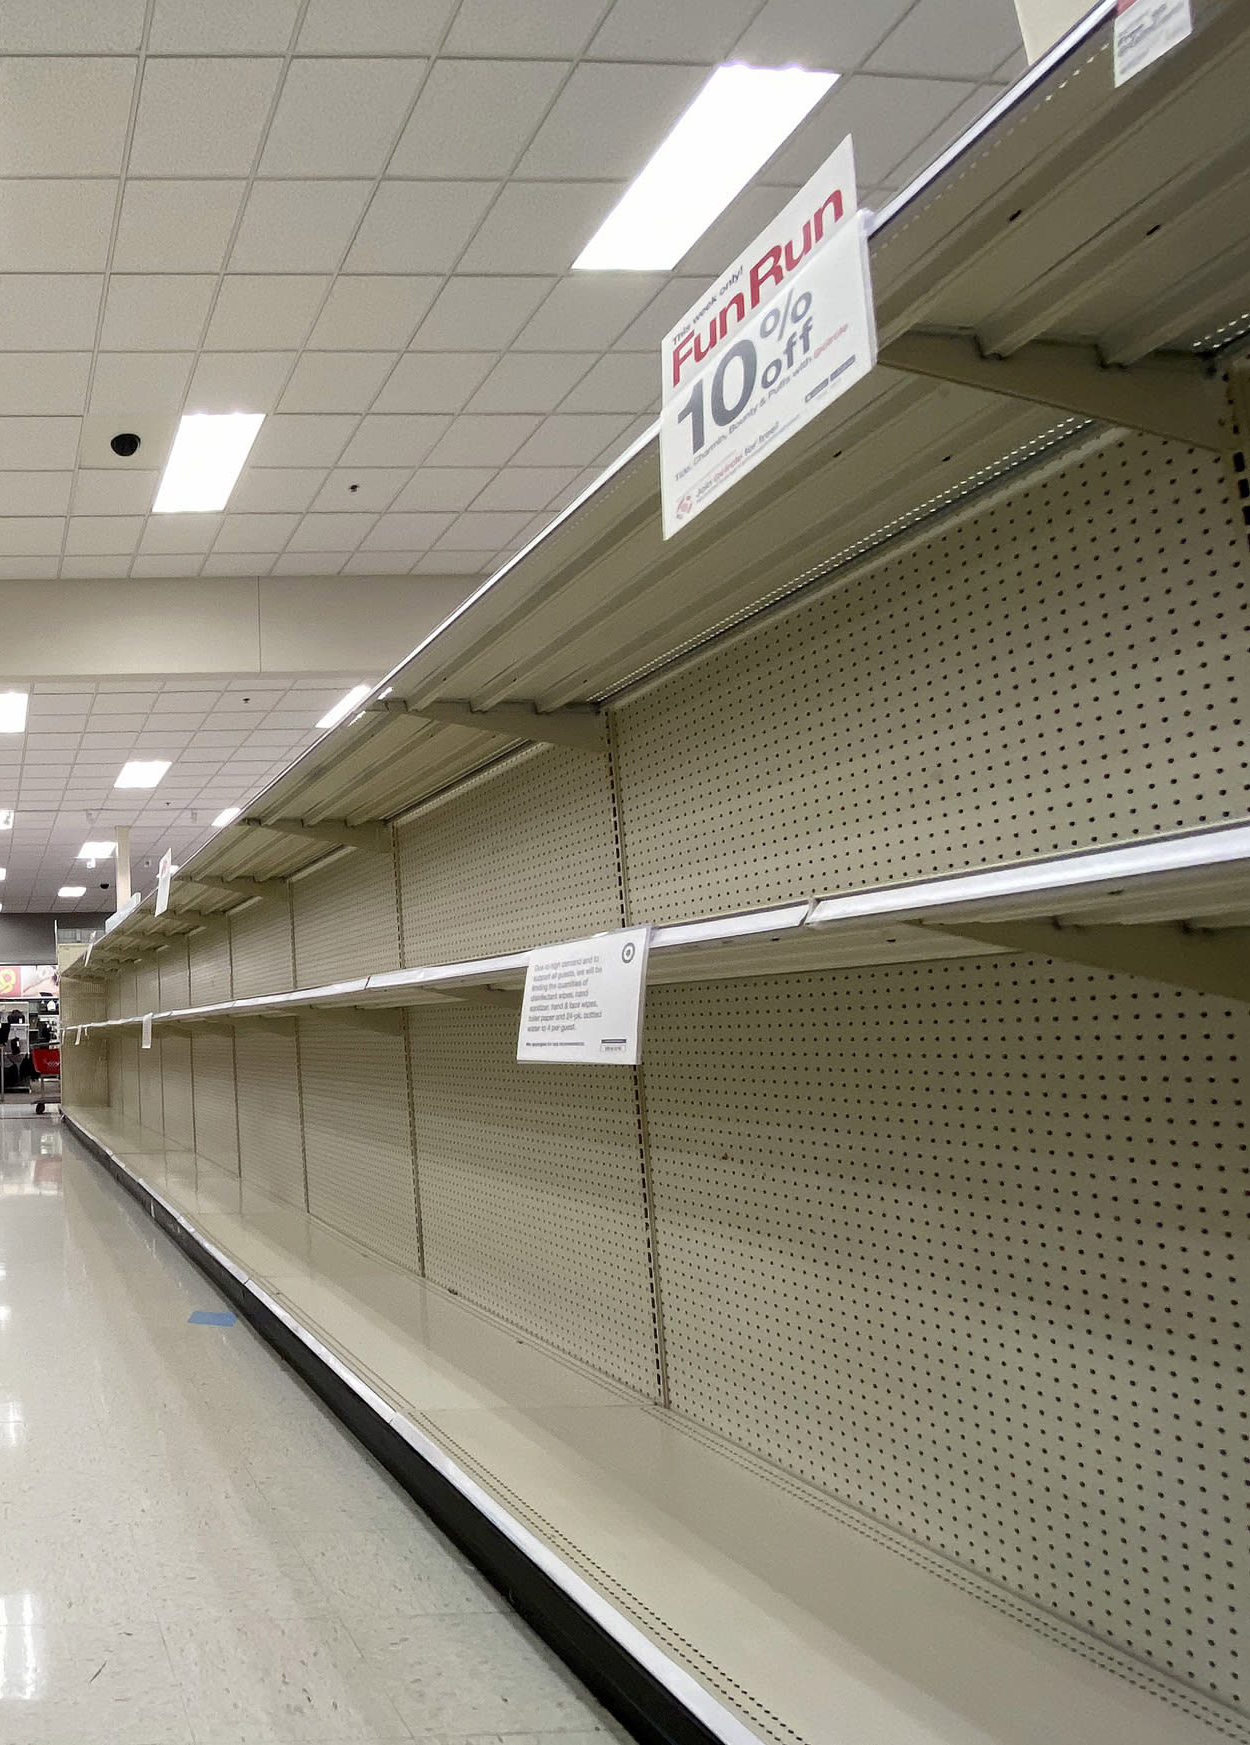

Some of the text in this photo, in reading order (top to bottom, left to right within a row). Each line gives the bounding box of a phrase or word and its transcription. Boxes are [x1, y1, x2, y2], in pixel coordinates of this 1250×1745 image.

[693, 296, 717, 324] week
[719, 265, 744, 296] only!
[761, 315, 813, 390] off
